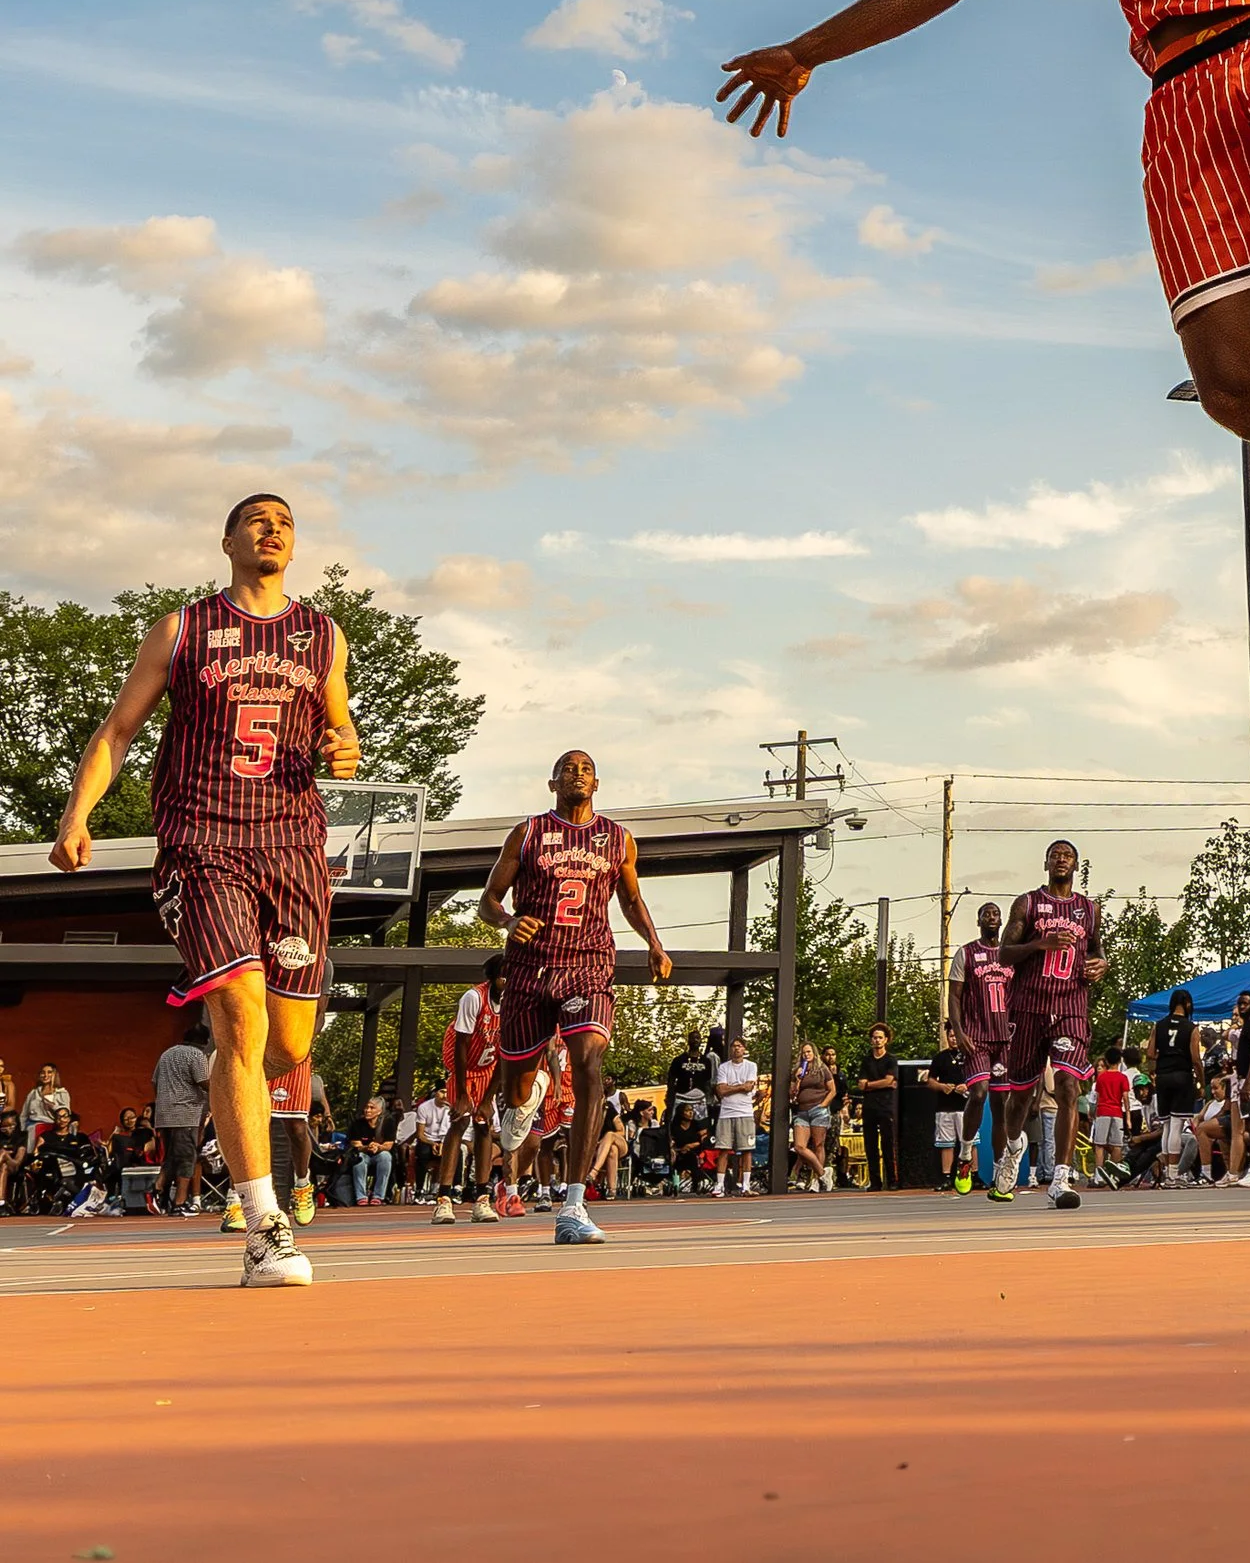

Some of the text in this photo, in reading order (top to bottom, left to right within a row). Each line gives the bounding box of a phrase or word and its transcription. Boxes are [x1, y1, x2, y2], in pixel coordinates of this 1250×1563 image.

[200, 651, 317, 692] Heritage
[227, 683, 295, 702] Classic
[231, 705, 281, 778] 5
[537, 847, 611, 873] Heritage
[554, 867, 597, 879] Classic
[554, 879, 587, 927] 2
[1042, 943, 1077, 980] 10
[988, 982, 1007, 1012] 11
[1168, 1029, 1178, 1047] 7
